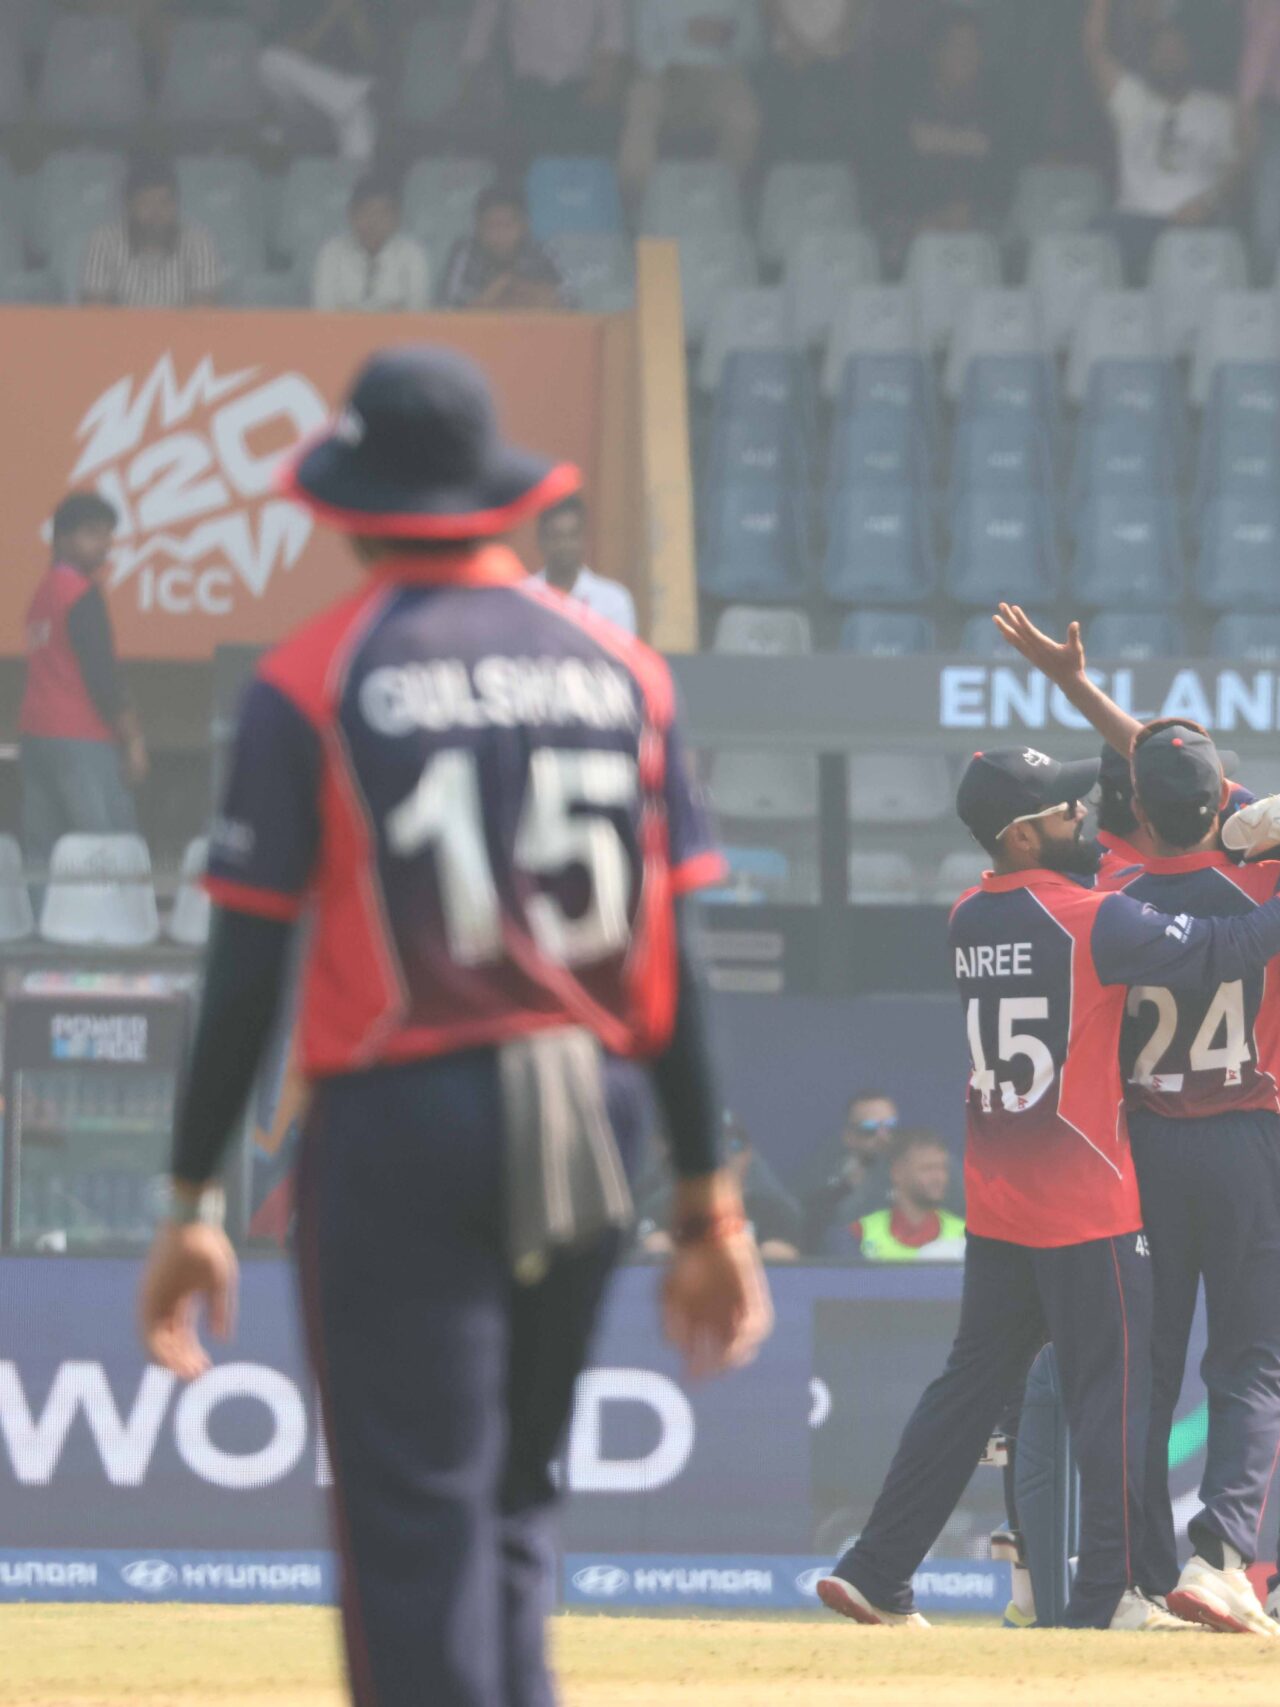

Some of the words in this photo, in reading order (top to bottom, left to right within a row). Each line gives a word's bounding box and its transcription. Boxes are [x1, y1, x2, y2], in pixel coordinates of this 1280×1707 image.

[137, 566, 233, 615] ICC
[385, 744, 637, 969] 15
[955, 942, 1033, 979] AIREE
[1127, 979, 1251, 1093] 24
[0, 1359, 695, 1491] WOD
[0, 1561, 98, 1586] UNDAI
[181, 1563, 322, 1590] HYUNDAI
[634, 1568, 773, 1594] HYUNDAI
